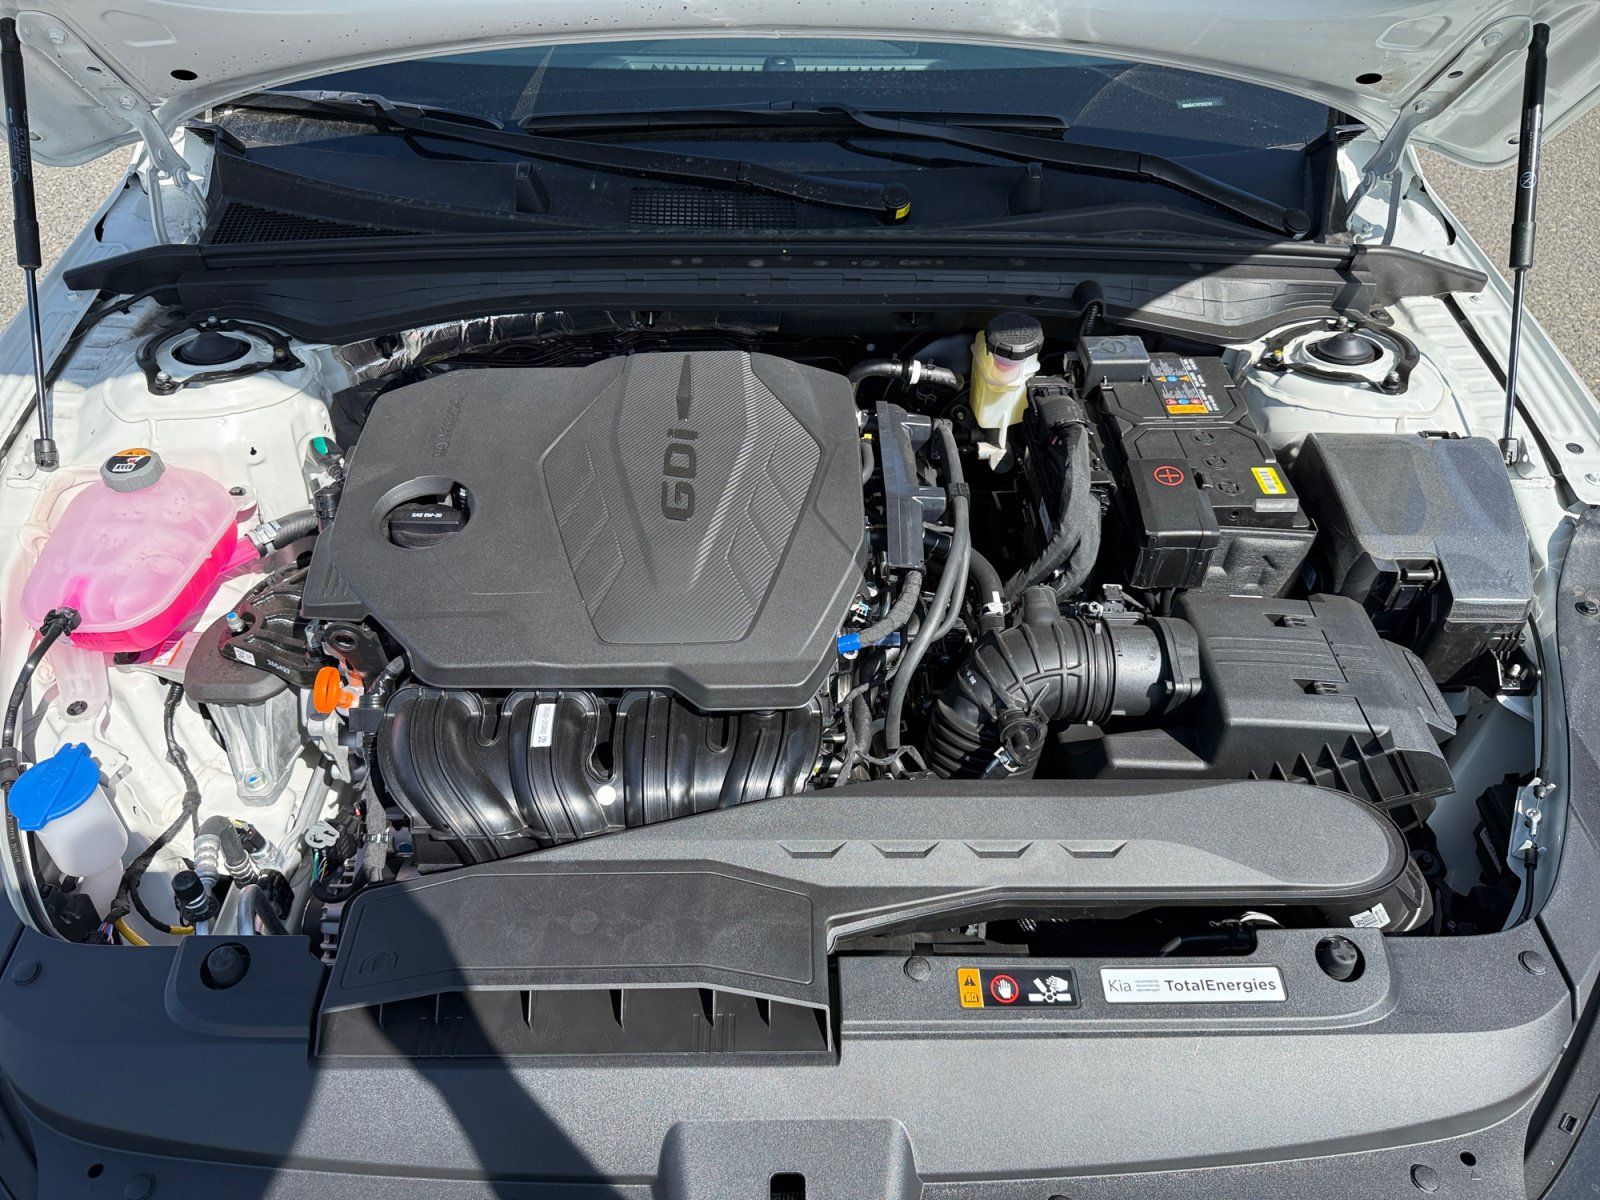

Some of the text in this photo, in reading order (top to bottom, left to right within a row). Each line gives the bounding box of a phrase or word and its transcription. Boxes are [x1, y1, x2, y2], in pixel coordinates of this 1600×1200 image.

[661, 428, 699, 521] GDi
[1107, 979, 1132, 992] Kia
[1164, 978, 1277, 993] TotalEnergies
